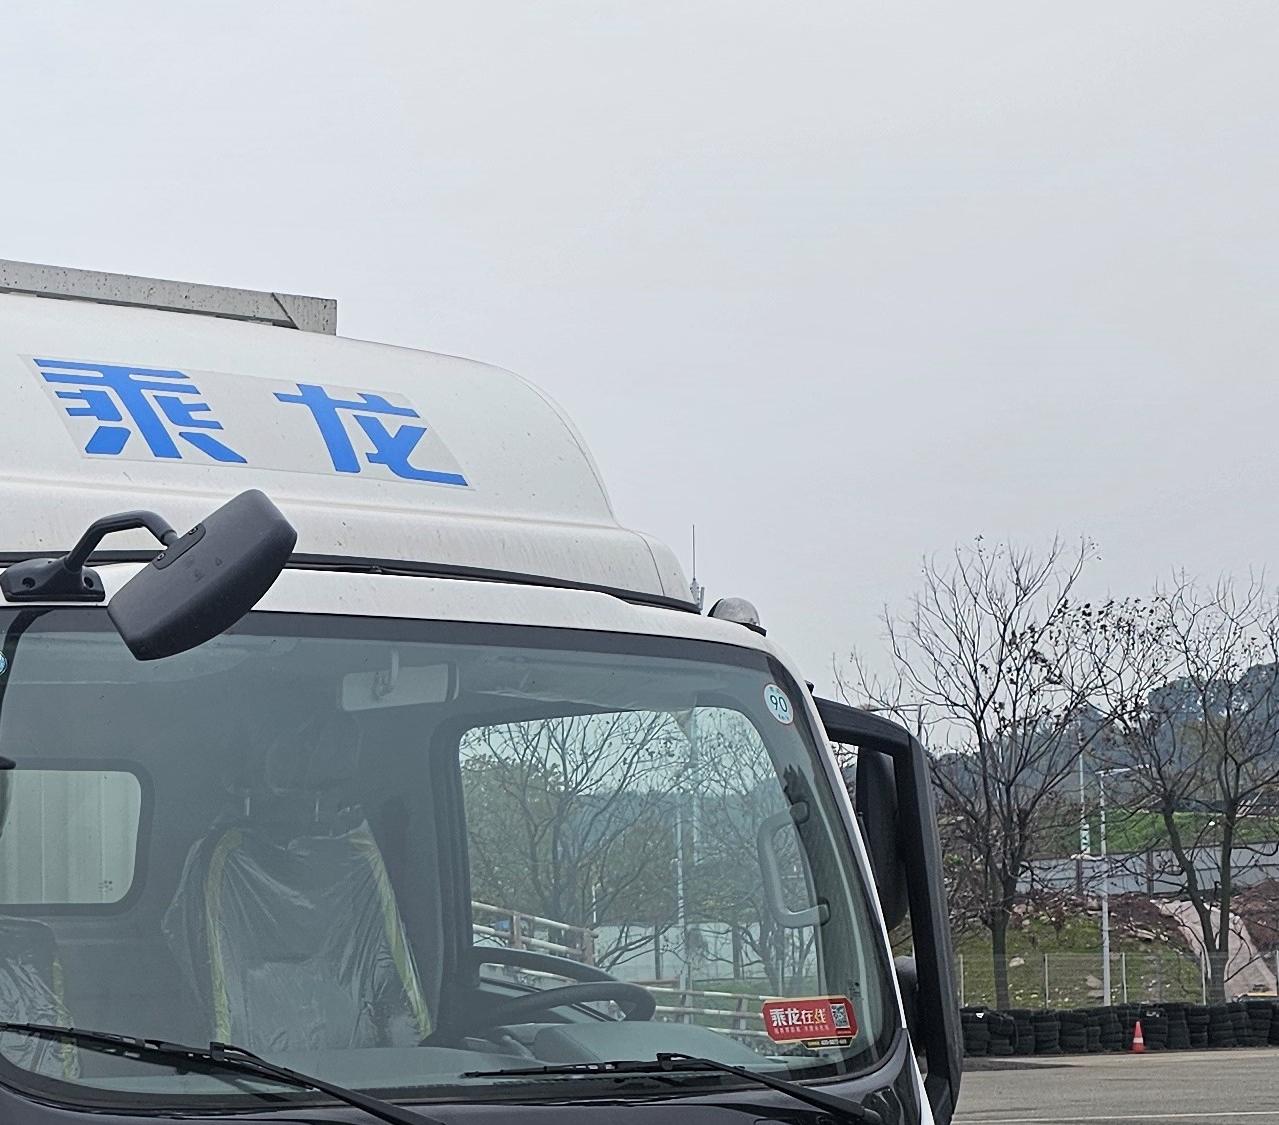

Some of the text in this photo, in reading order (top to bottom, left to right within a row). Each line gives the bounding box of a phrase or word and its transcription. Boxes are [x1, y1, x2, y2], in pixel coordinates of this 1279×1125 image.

[33, 358, 469, 486] 乘龙
[769, 694, 788, 713] 90
[770, 1008, 827, 1026] 乘龙在线
